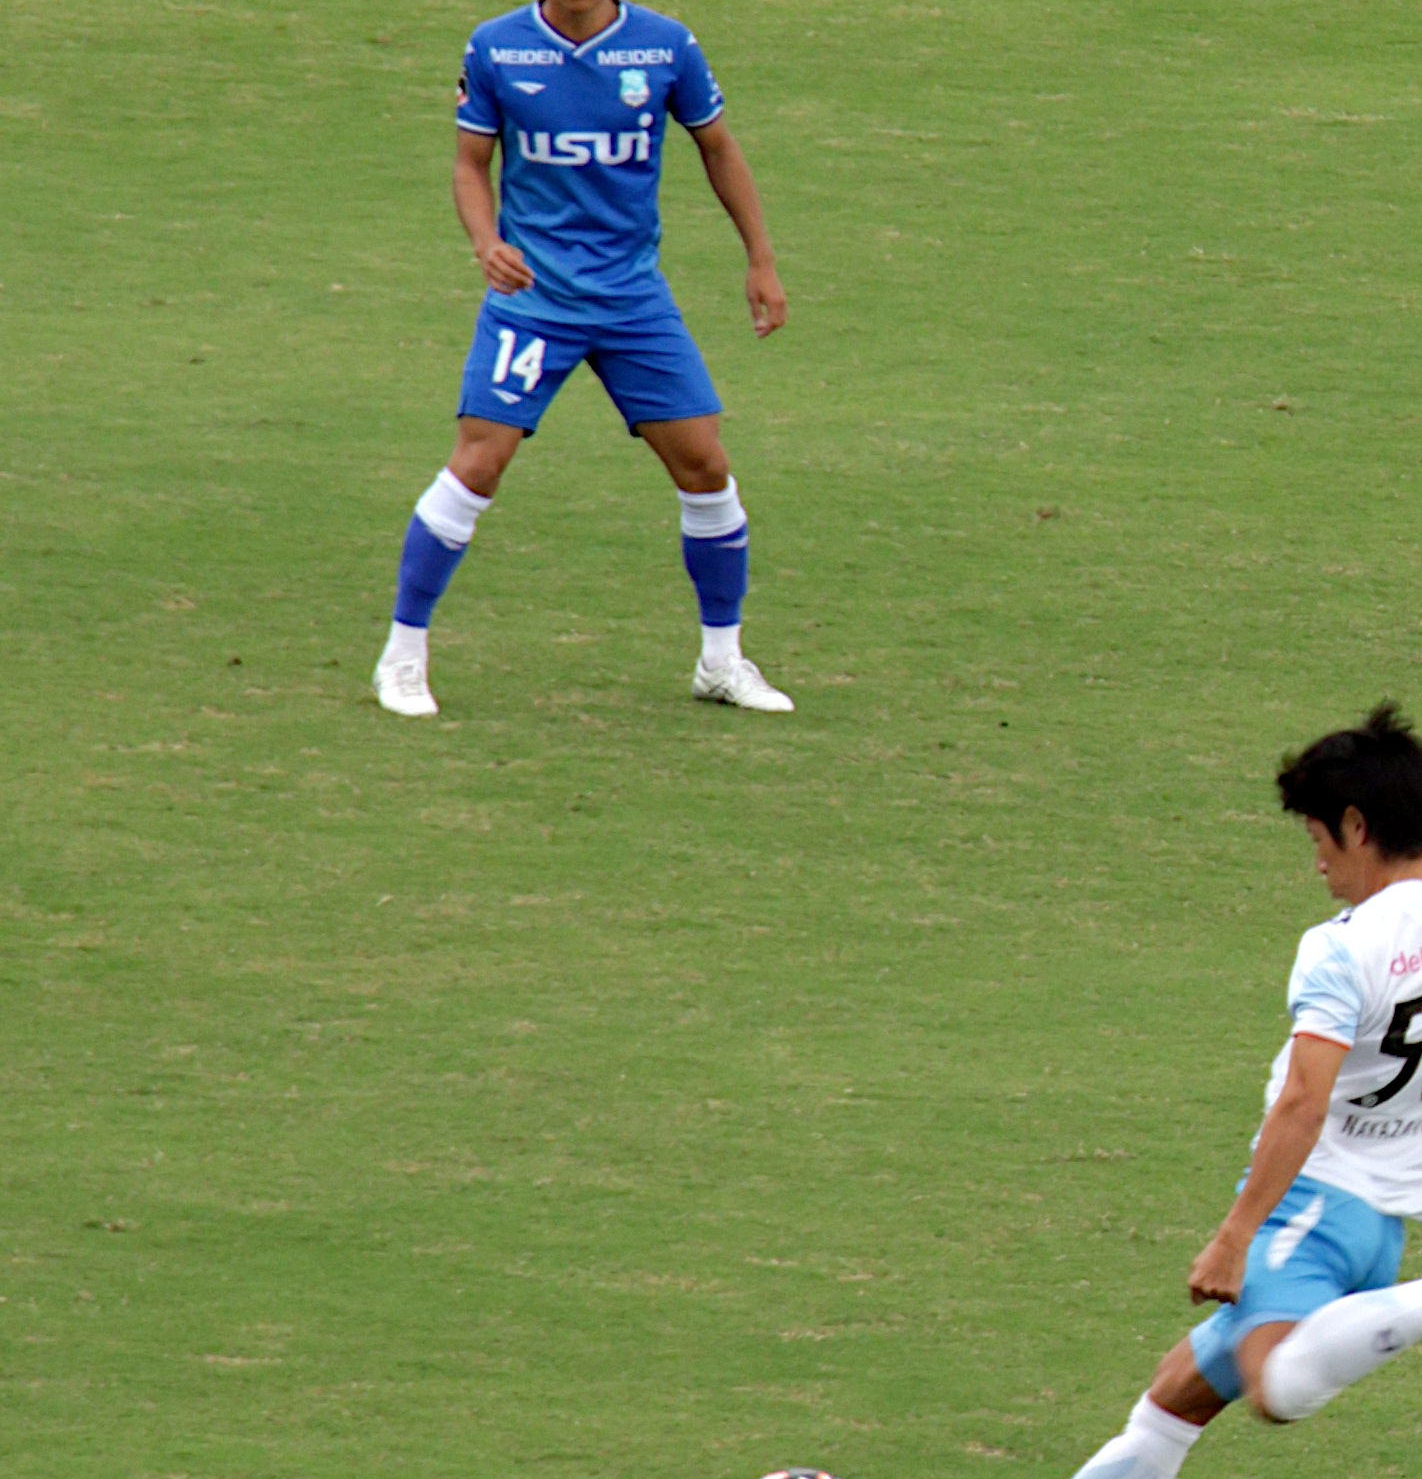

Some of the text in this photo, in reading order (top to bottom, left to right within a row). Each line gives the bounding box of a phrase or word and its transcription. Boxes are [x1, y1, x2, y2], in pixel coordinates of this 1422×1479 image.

[489, 47, 674, 66] MEIDEN MEIDEN
[492, 328, 546, 393] 14
